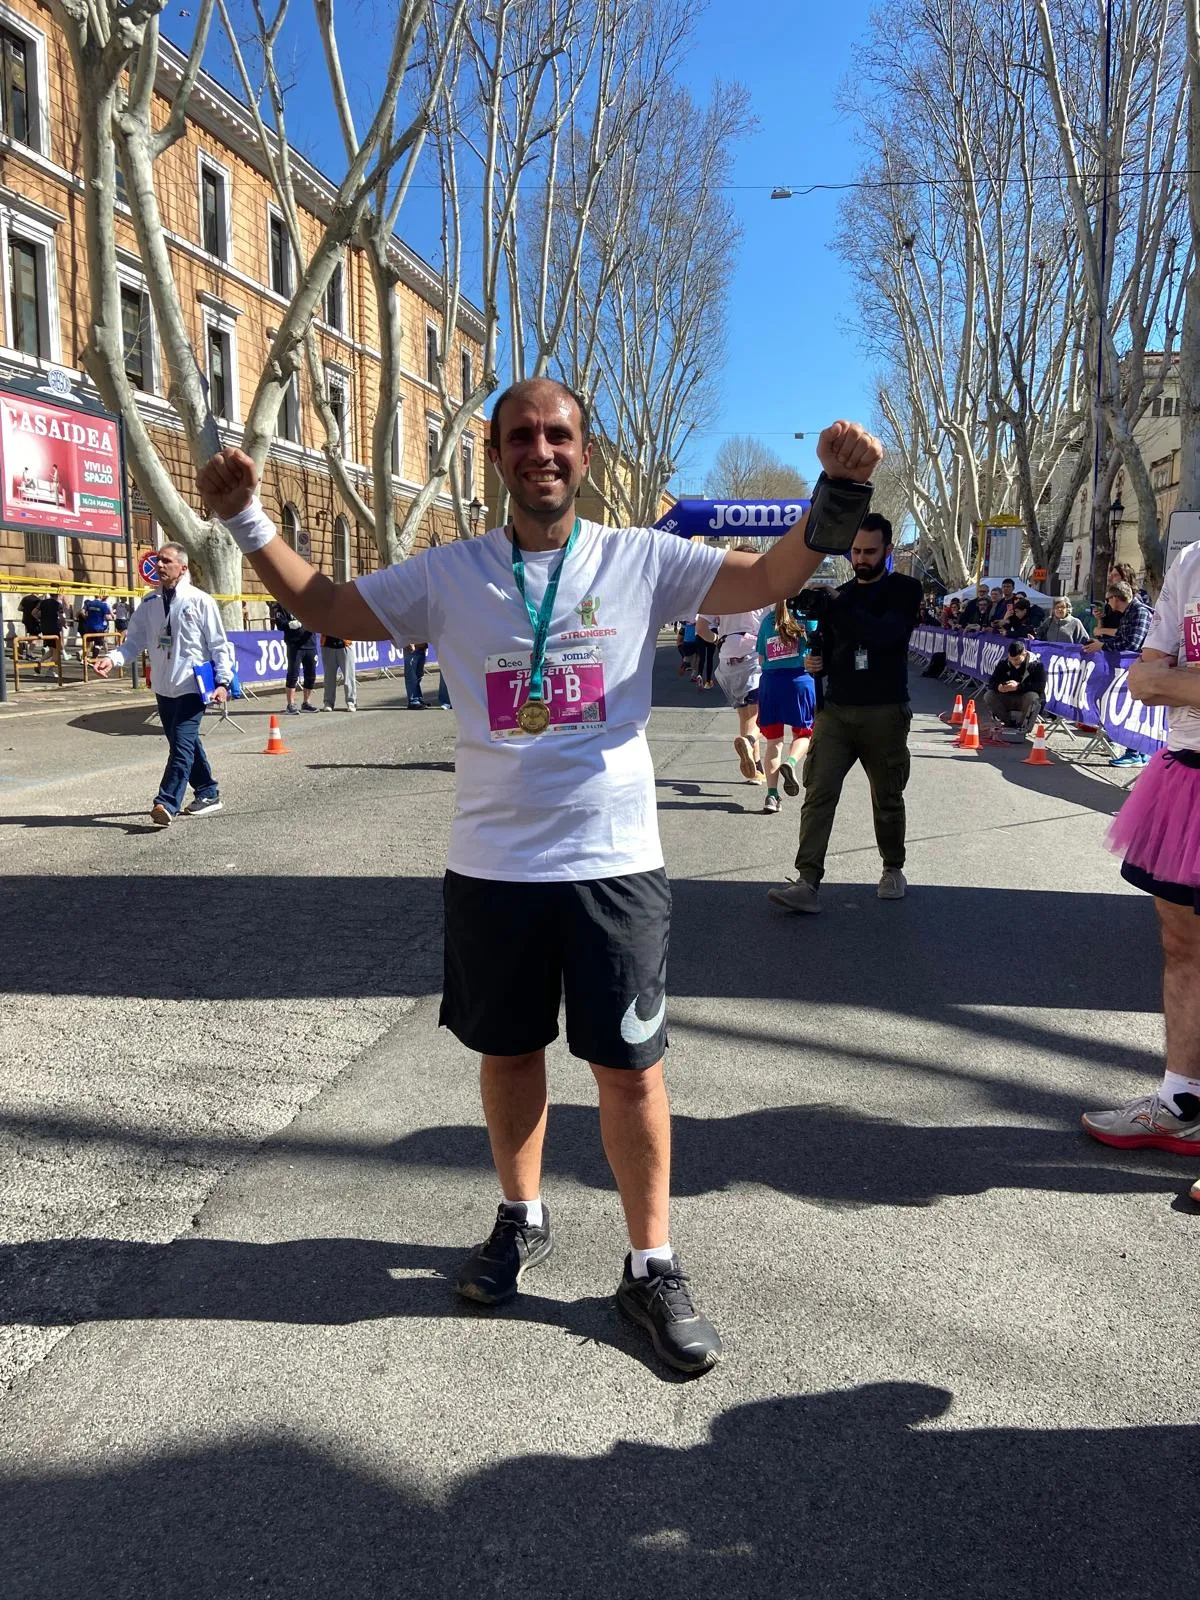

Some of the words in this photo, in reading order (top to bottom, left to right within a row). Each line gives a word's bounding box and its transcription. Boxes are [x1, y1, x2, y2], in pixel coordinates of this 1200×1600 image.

[7, 407, 113, 452] CASAIDEA
[84, 460, 100, 473] VIVI
[102, 464, 112, 474] LO
[84, 472, 113, 485] SPAZIO
[709, 504, 803, 530] Joma
[560, 628, 617, 640] STRONGERS
[516, 665, 574, 679] STAFETTA
[509, 674, 581, 708] 70-B
